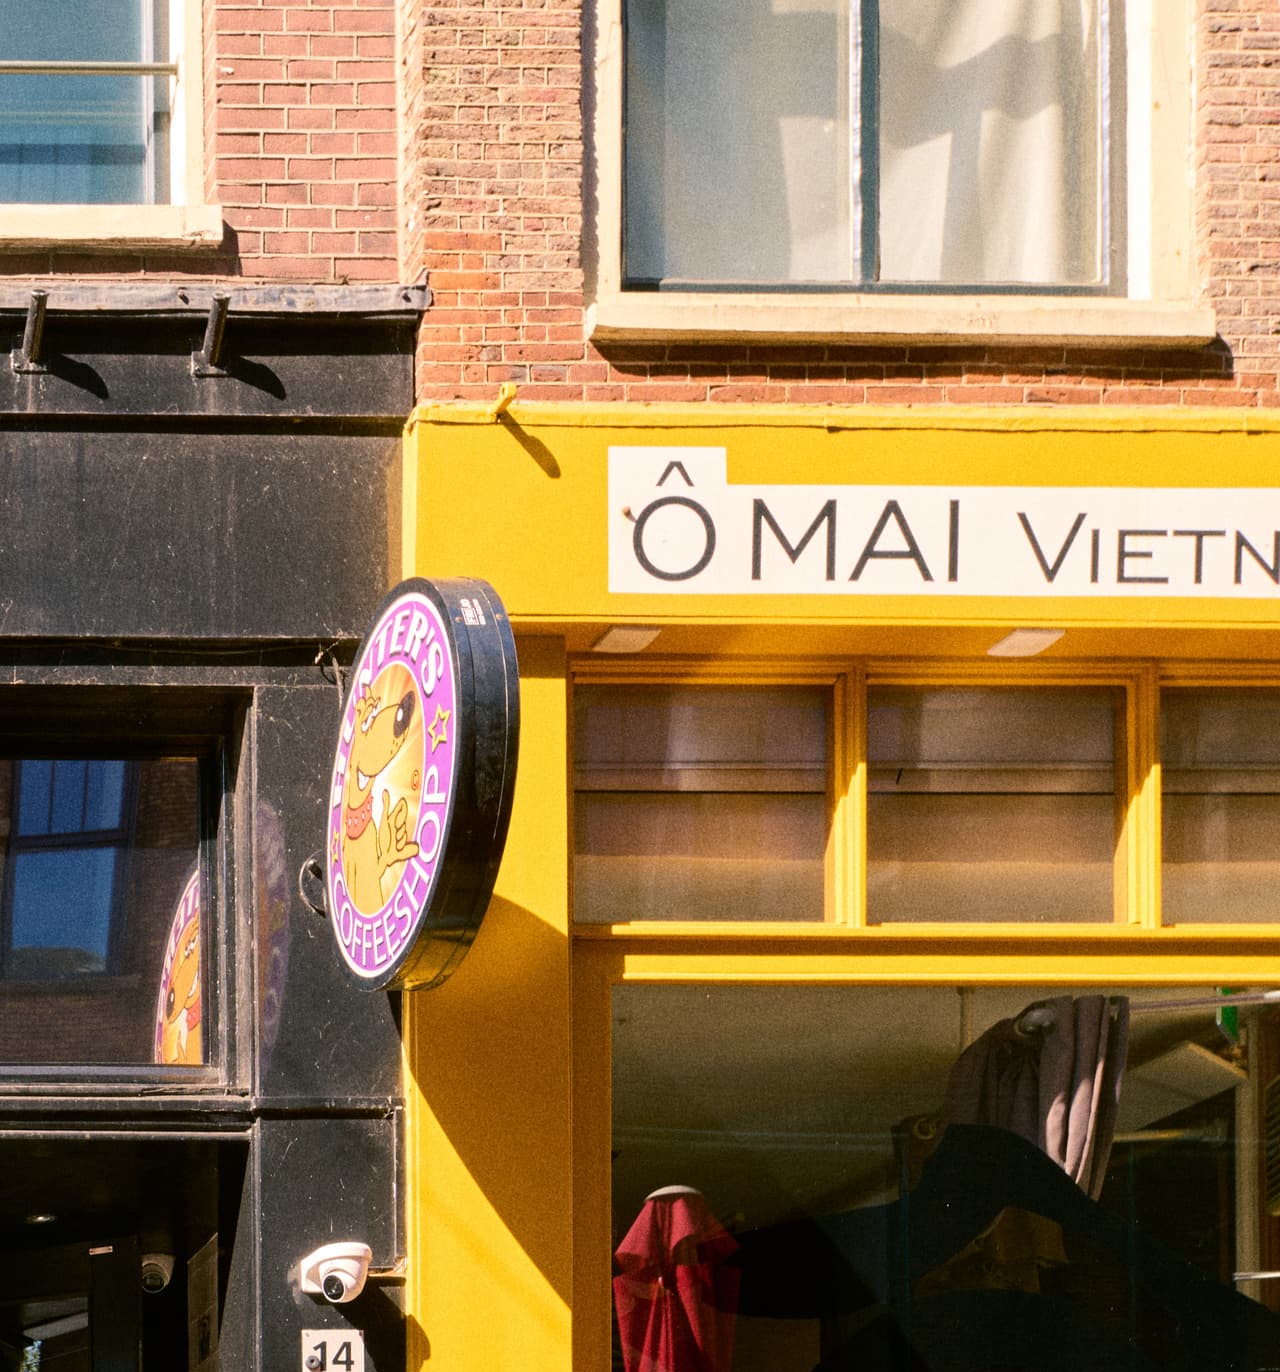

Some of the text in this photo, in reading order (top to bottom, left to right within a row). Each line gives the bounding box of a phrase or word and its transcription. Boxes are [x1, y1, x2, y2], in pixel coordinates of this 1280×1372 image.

[633, 460, 716, 582] Ô
[751, 499, 961, 582] MAI
[334, 764, 448, 967] COFFEESHOP
[312, 1340, 355, 1372] 14
